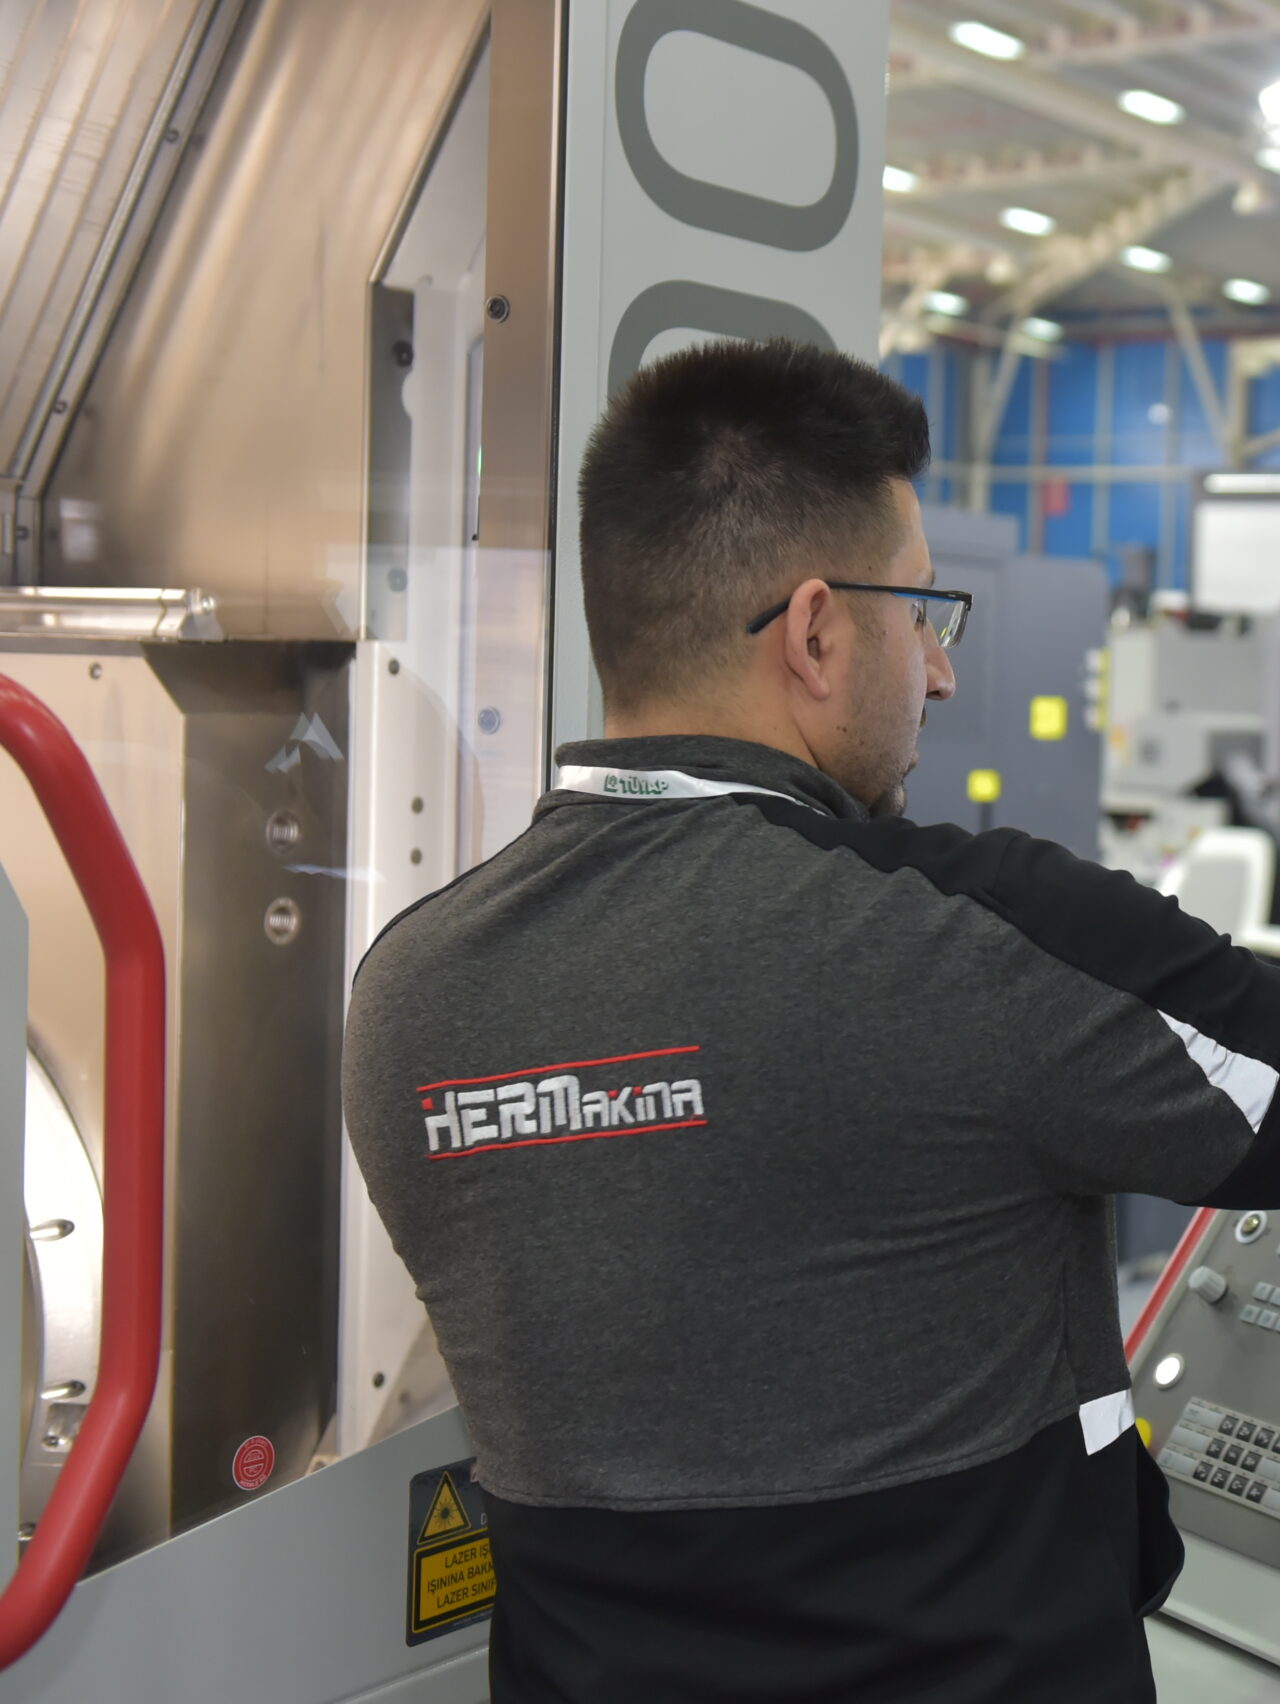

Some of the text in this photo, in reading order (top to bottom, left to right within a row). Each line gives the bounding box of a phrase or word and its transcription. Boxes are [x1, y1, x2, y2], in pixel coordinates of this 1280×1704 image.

[445, 1547, 477, 1568] LAZER
[428, 1570, 465, 1595] IŞININA
[437, 1587, 469, 1608] LAZER
